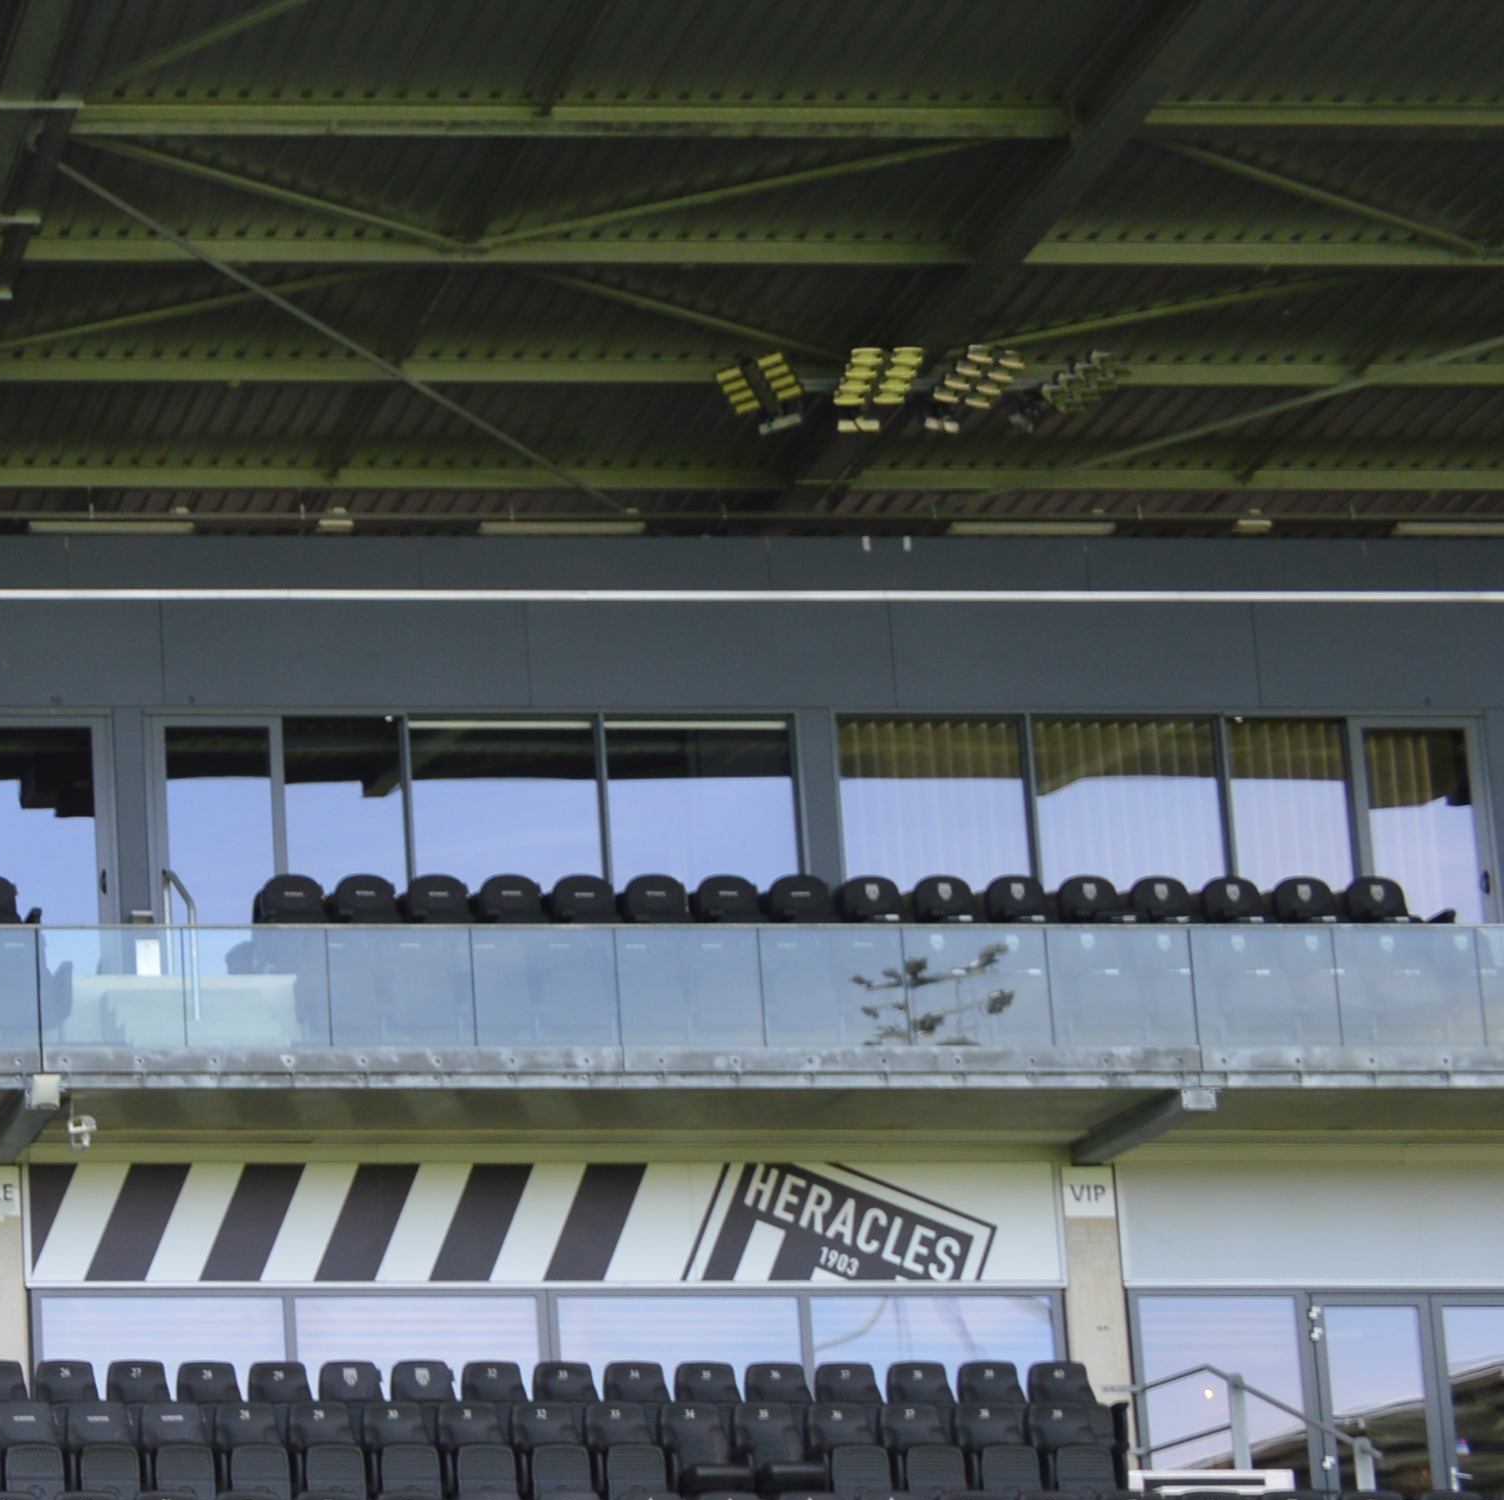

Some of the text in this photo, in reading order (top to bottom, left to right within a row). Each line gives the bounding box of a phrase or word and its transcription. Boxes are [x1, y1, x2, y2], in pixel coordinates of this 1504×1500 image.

[1069, 1184, 1106, 1202] VIP
[744, 1167, 961, 1281] HERACLES
[819, 1247, 859, 1276] 1903
